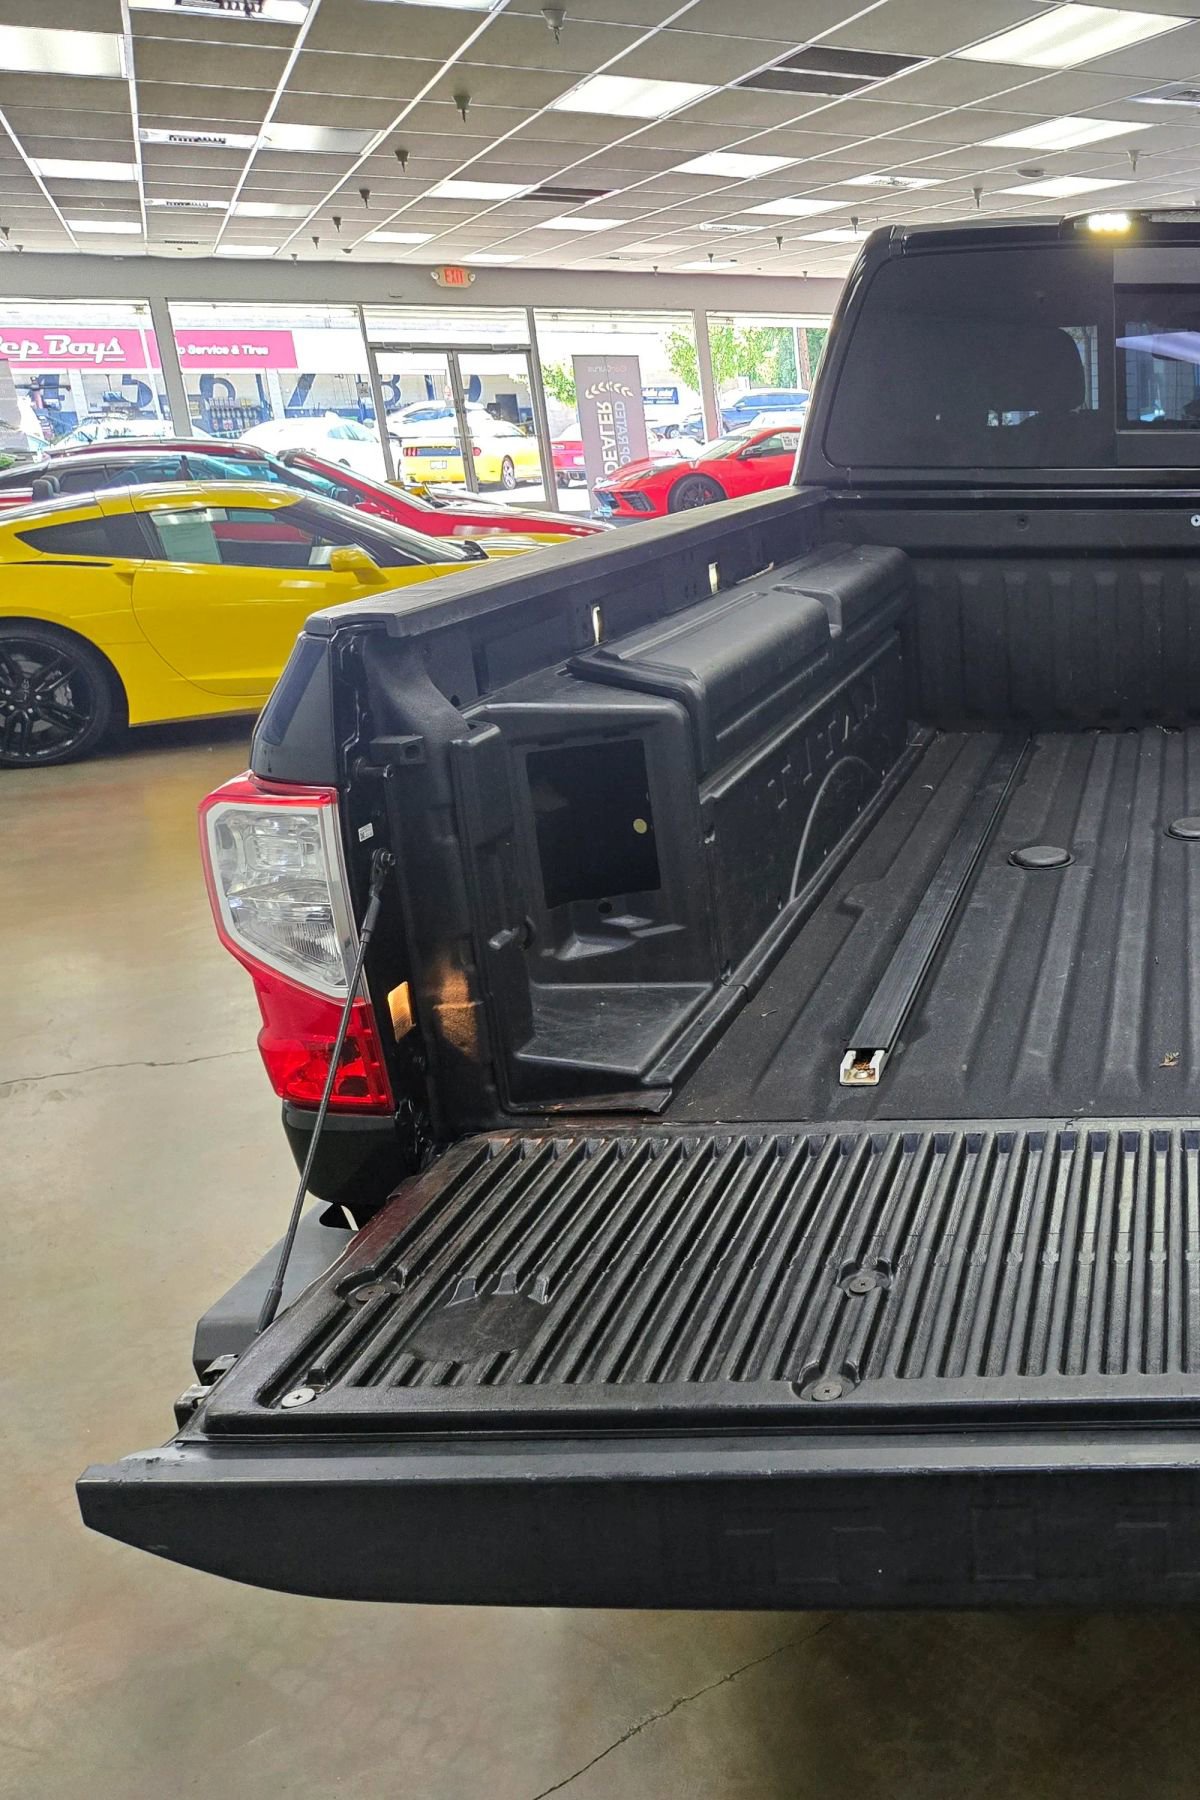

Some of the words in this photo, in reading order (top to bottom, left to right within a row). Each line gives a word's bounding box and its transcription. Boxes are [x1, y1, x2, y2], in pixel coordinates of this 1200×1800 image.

[445, 267, 464, 283] EXIT
[0, 335, 43, 360] ep
[43, 333, 126, 365] Boys
[187, 344, 230, 356] Service
[230, 344, 240, 356] &
[241, 344, 270, 356] Tires
